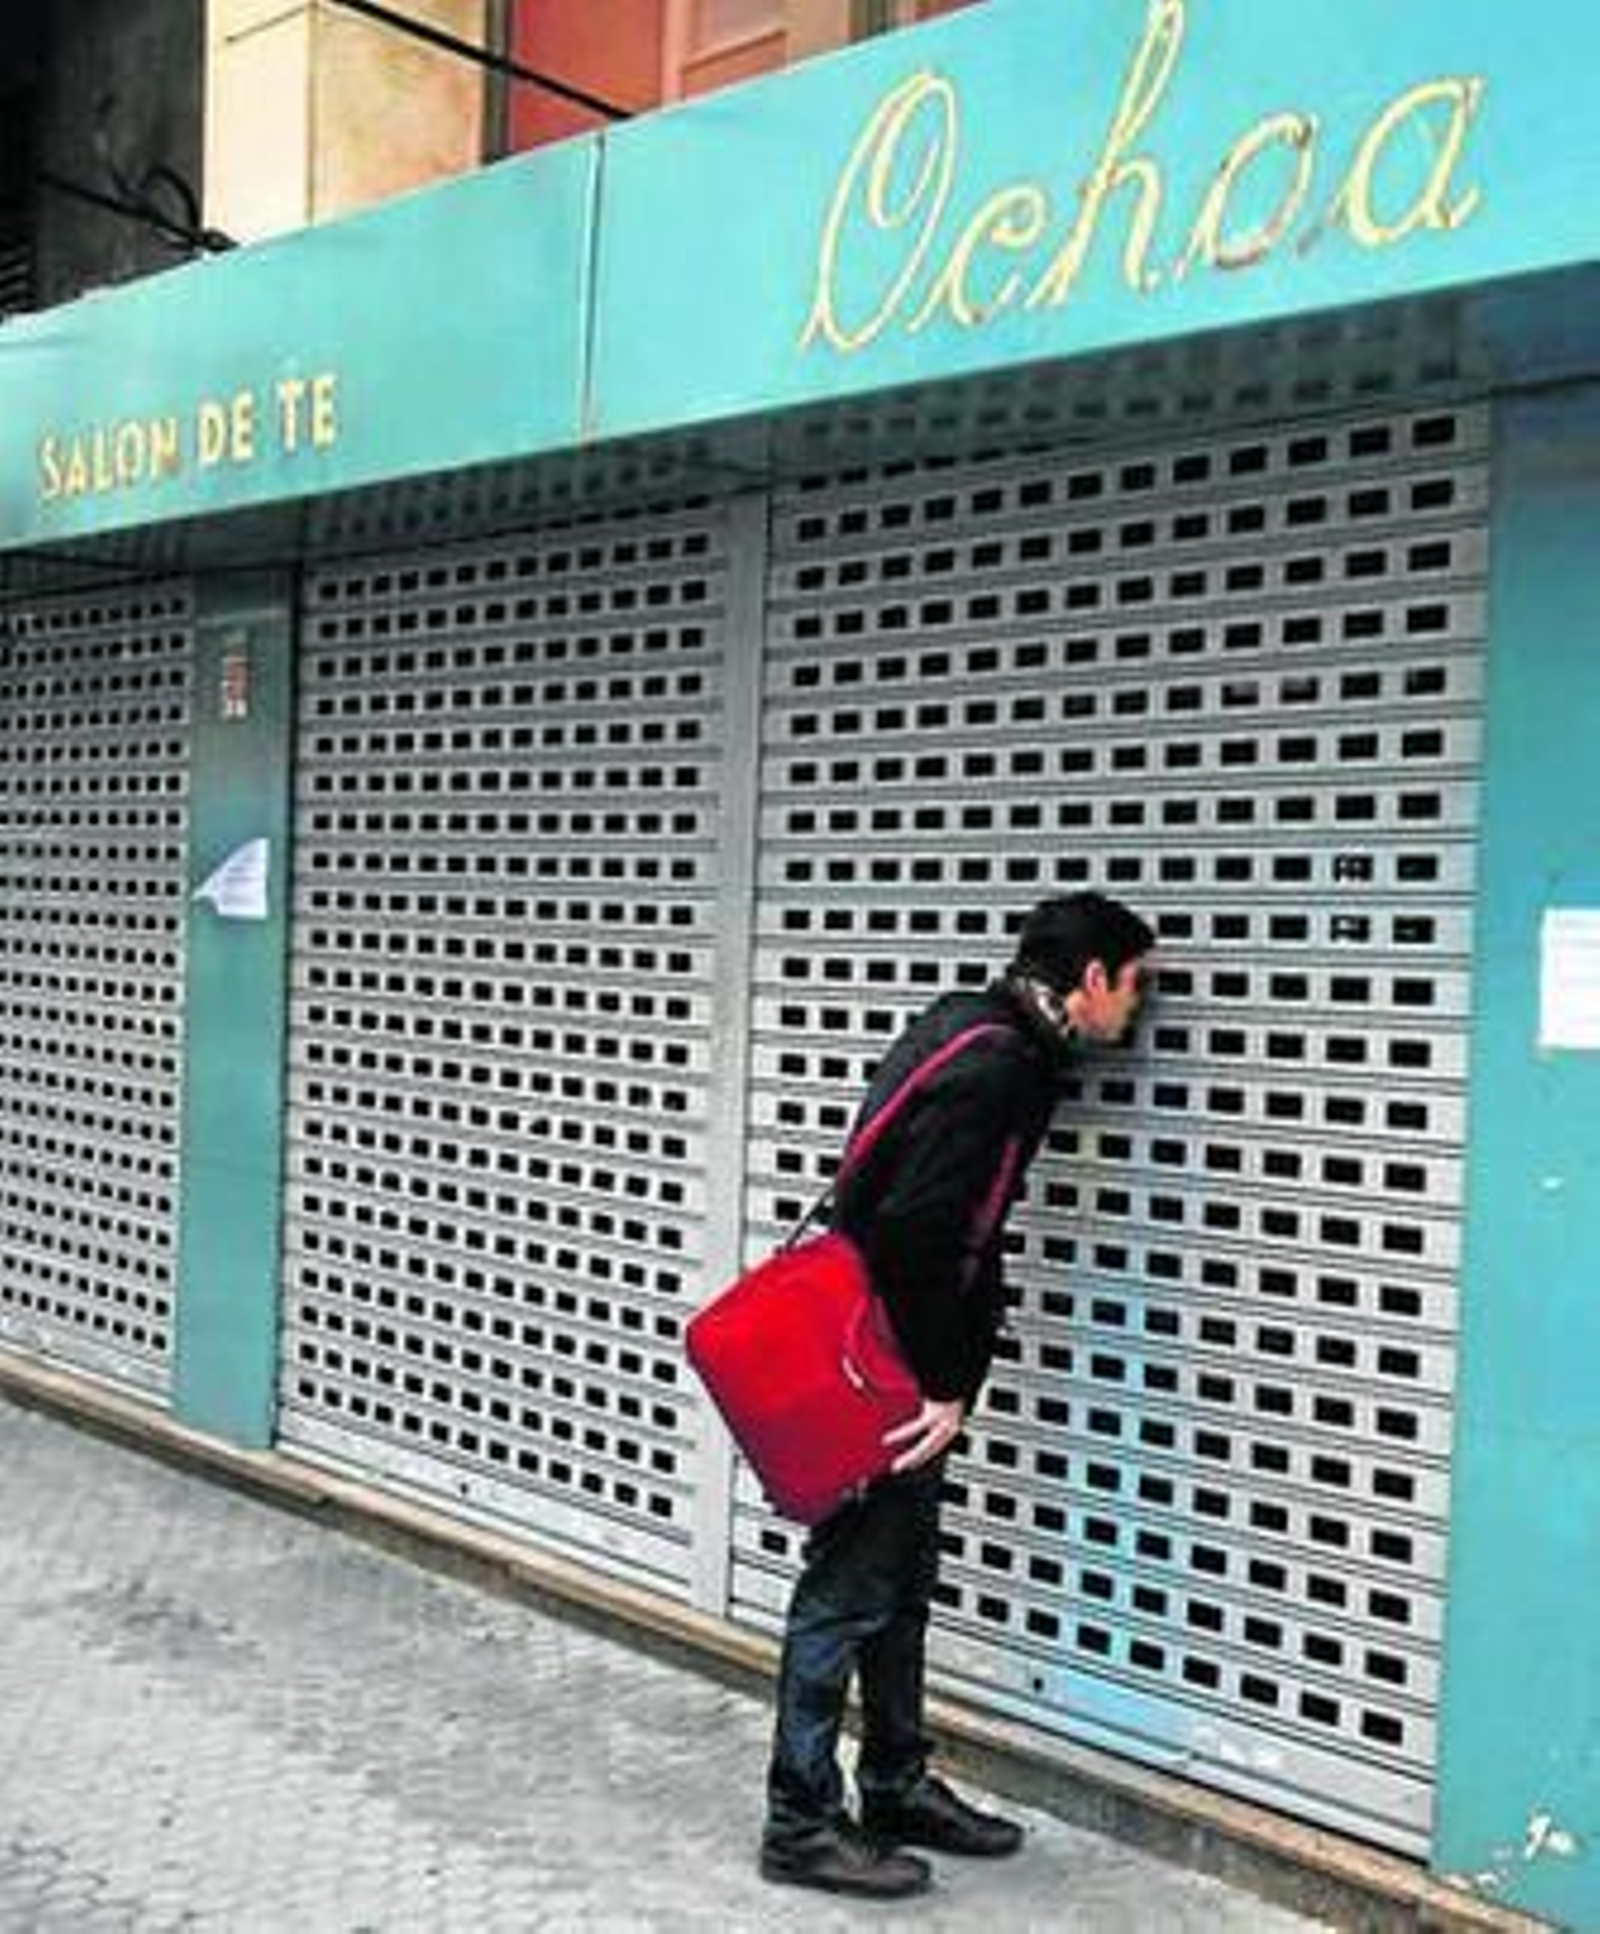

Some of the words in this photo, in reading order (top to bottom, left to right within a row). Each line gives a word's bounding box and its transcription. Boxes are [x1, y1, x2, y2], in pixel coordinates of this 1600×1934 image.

[799, 0, 1486, 353] Ochoa
[38, 416, 178, 497] SALON
[200, 388, 254, 467] DE
[277, 373, 338, 451] TE
